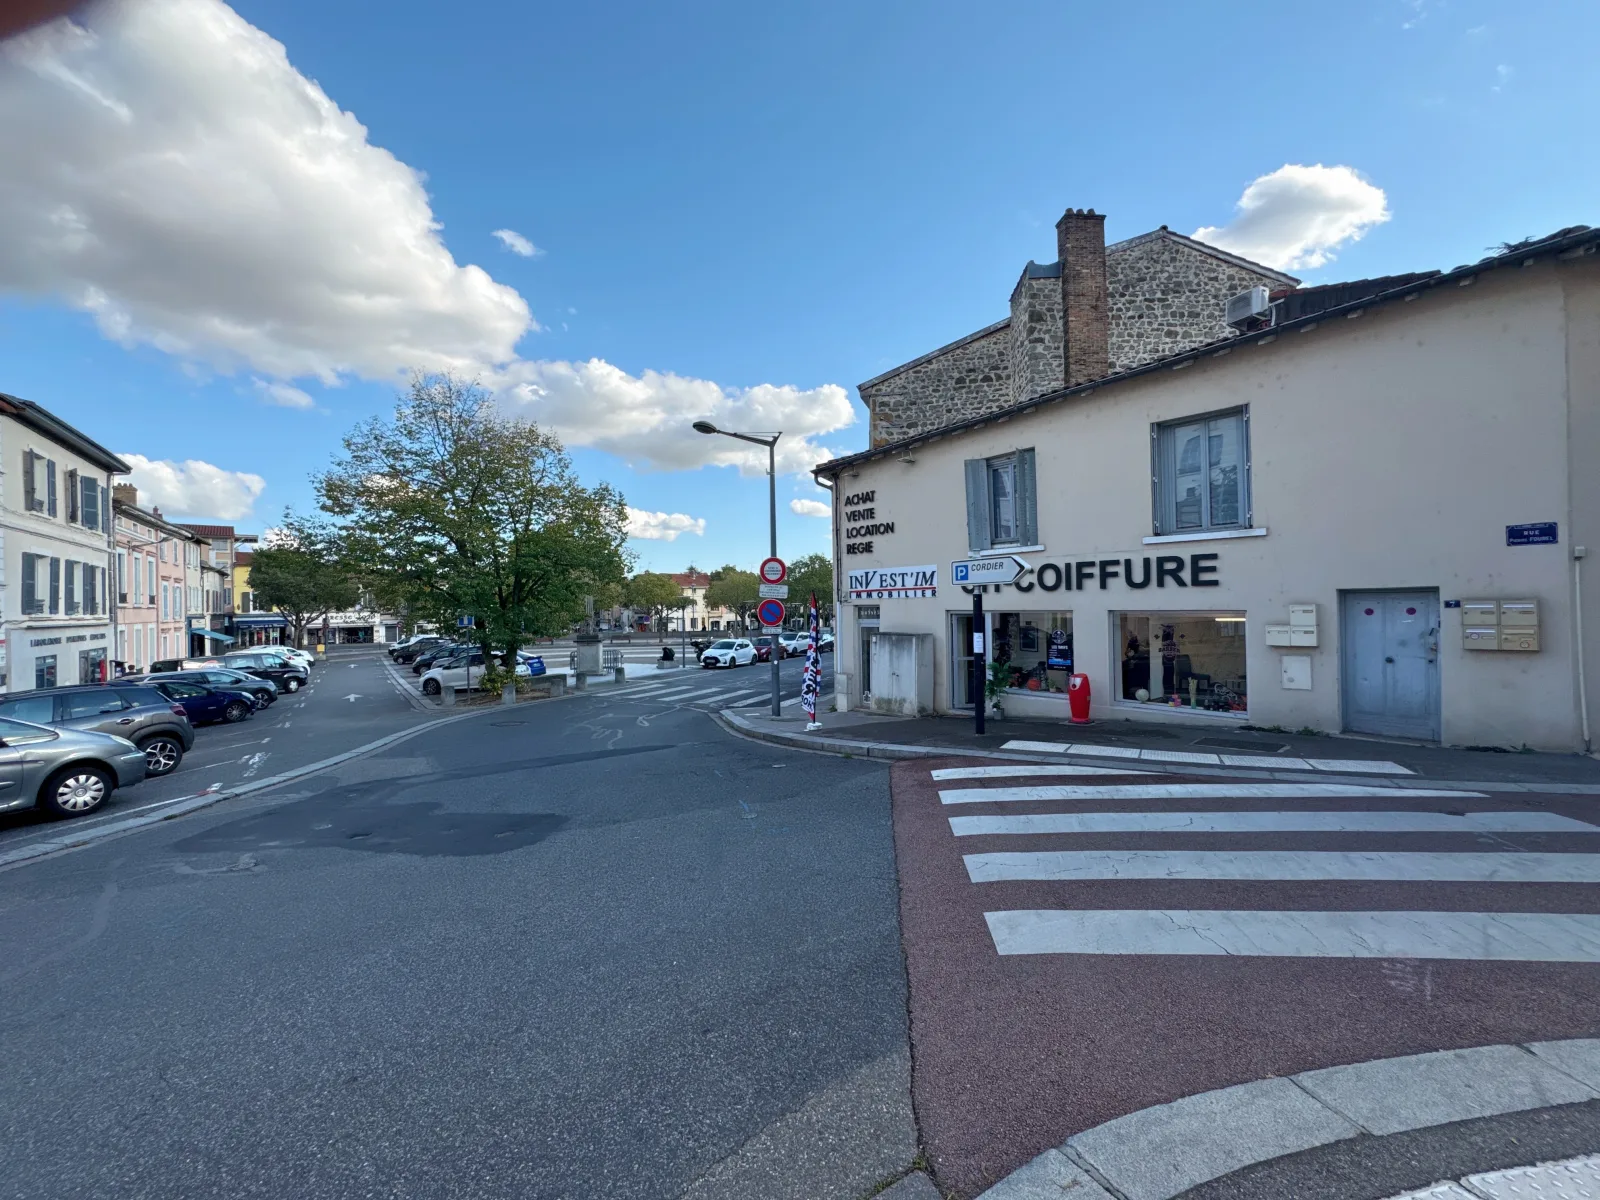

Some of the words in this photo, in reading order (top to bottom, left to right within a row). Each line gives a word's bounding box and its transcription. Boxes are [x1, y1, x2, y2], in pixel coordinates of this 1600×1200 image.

[844, 490, 876, 507] ACHAT
[845, 508, 875, 522] VENTE
[846, 522, 895, 539] LOCATION
[846, 541, 874, 555] REGIE
[970, 561, 1004, 572] CORDIER
[849, 590, 937, 599] IMMOBILIER
